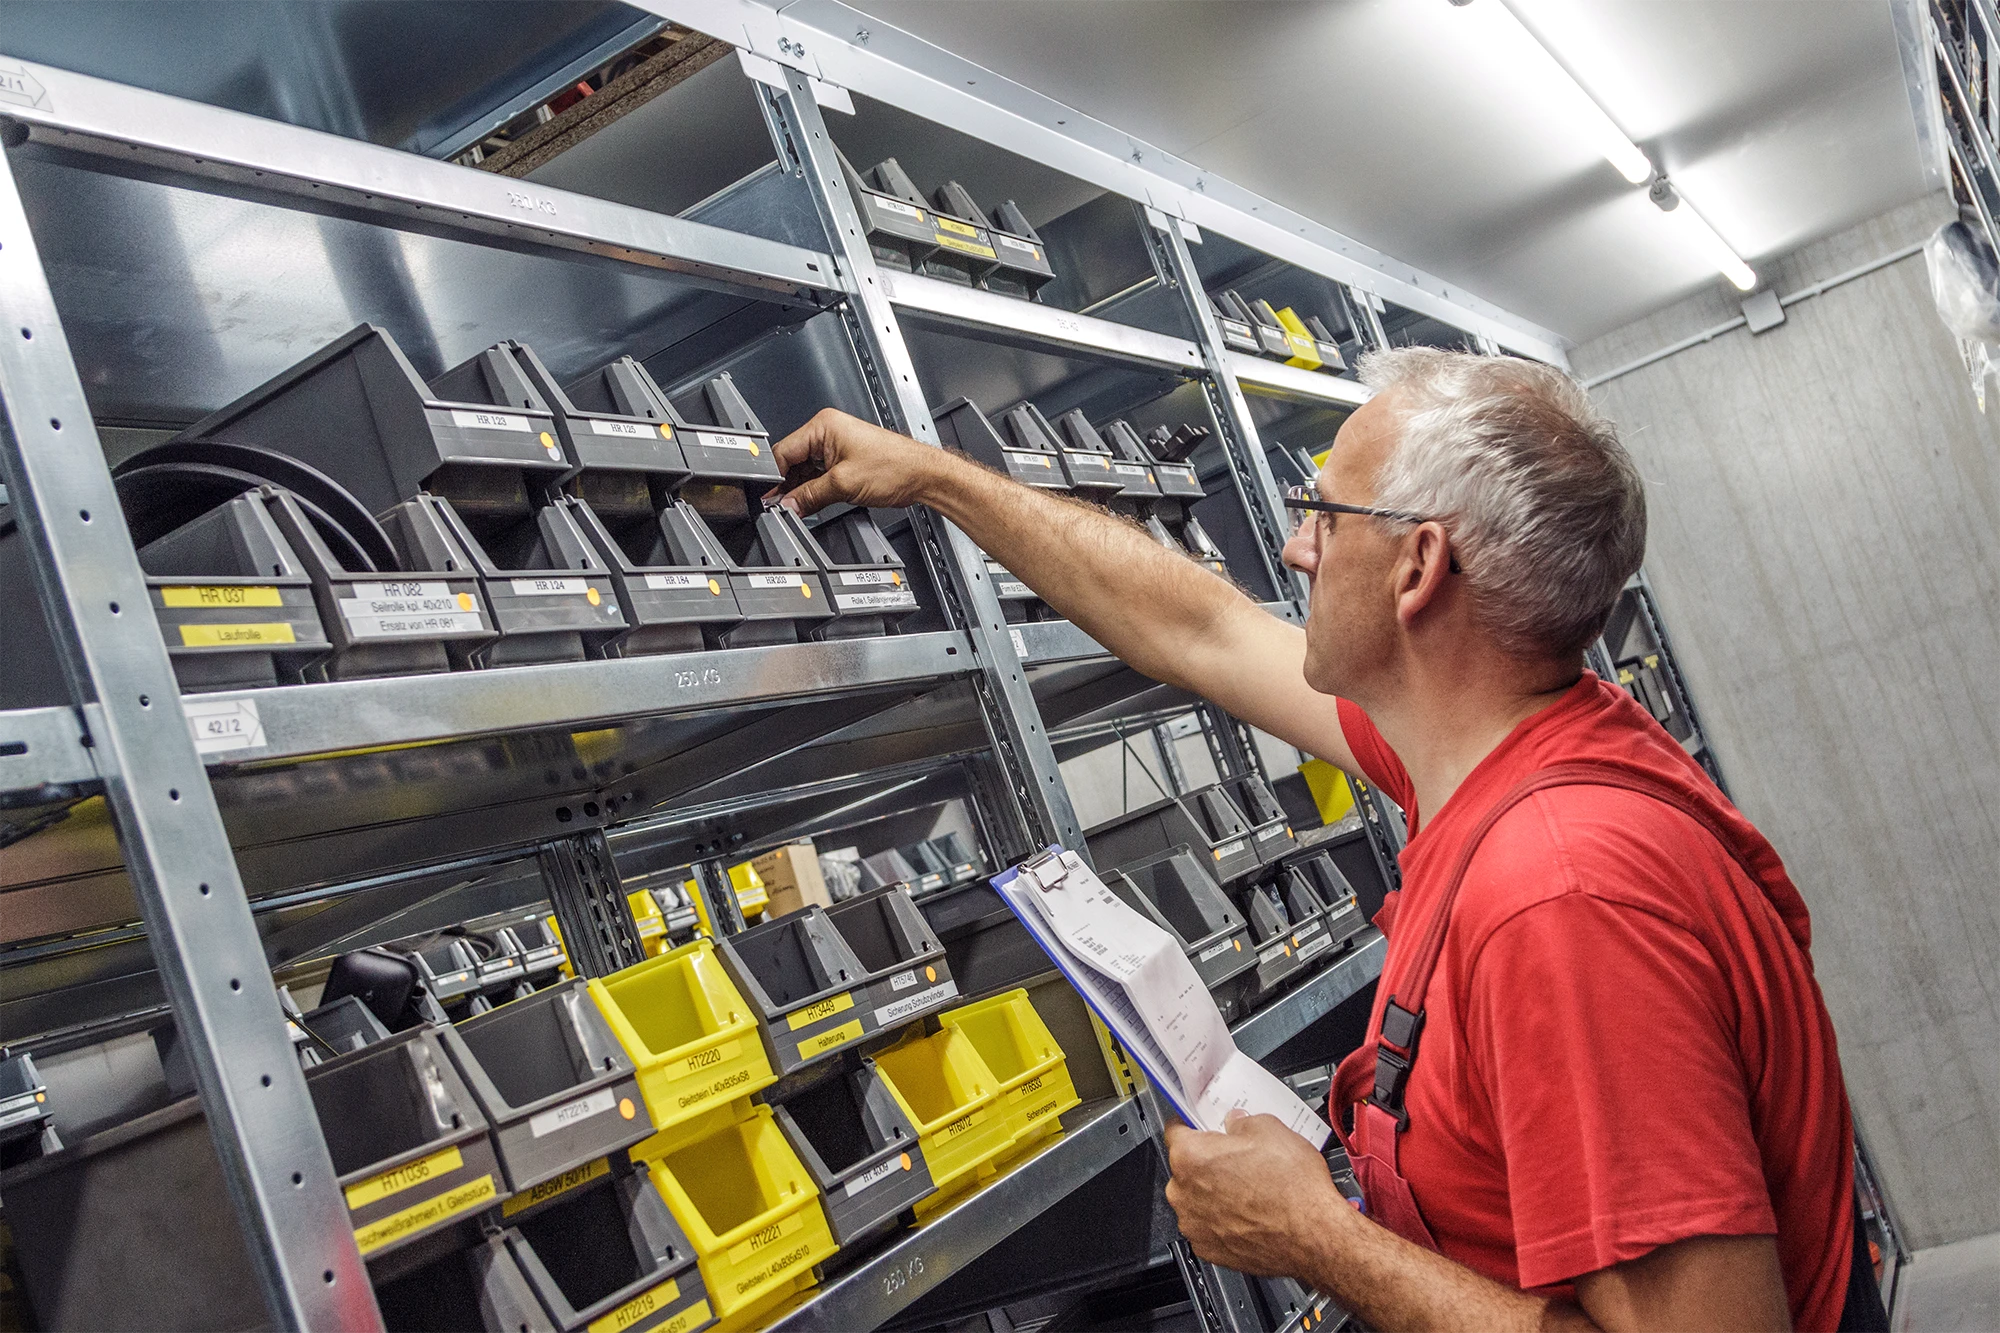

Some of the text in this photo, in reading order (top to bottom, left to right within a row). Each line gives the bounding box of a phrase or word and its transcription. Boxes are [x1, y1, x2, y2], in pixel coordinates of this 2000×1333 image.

[535, 198, 558, 215] KG
[476, 414, 507, 426] HR 123
[610, 423, 637, 434] HR 125
[714, 435, 725, 445] HR
[535, 580, 565, 591] HR 124
[664, 575, 676, 585] HR
[765, 576, 776, 584] HR
[854, 574, 866, 582] HR
[200, 588, 245, 602] HR 037
[383, 583, 424, 596] HR 082
[371, 601, 405, 613] Seilrolle
[423, 599, 452, 611] 40x210
[380, 618, 455, 632] Ersatz von HR 081
[217, 629, 262, 641] Laufrolle
[674, 667, 721, 687] 250 KG
[806, 1000, 835, 1021] HT3449
[887, 989, 945, 1018] Sicherung Schubzylinder
[817, 1031, 846, 1048] Halterung
[687, 1048, 722, 1071] HT2220
[678, 1070, 750, 1108] Gleitstein L40xB35xS8
[557, 1101, 590, 1122] HT2218
[1026, 1100, 1058, 1122] Sicherungsring
[948, 1115, 973, 1137] HT6012
[381, 1160, 429, 1192] HT1036
[446, 1183, 493, 1209] Gleitstück
[749, 1224, 782, 1251] HT2221
[736, 1244, 810, 1294] Gleitstein L40xB35xS10
[883, 1256, 924, 1295] 250 KG
[616, 1294, 655, 1327] HT2219
